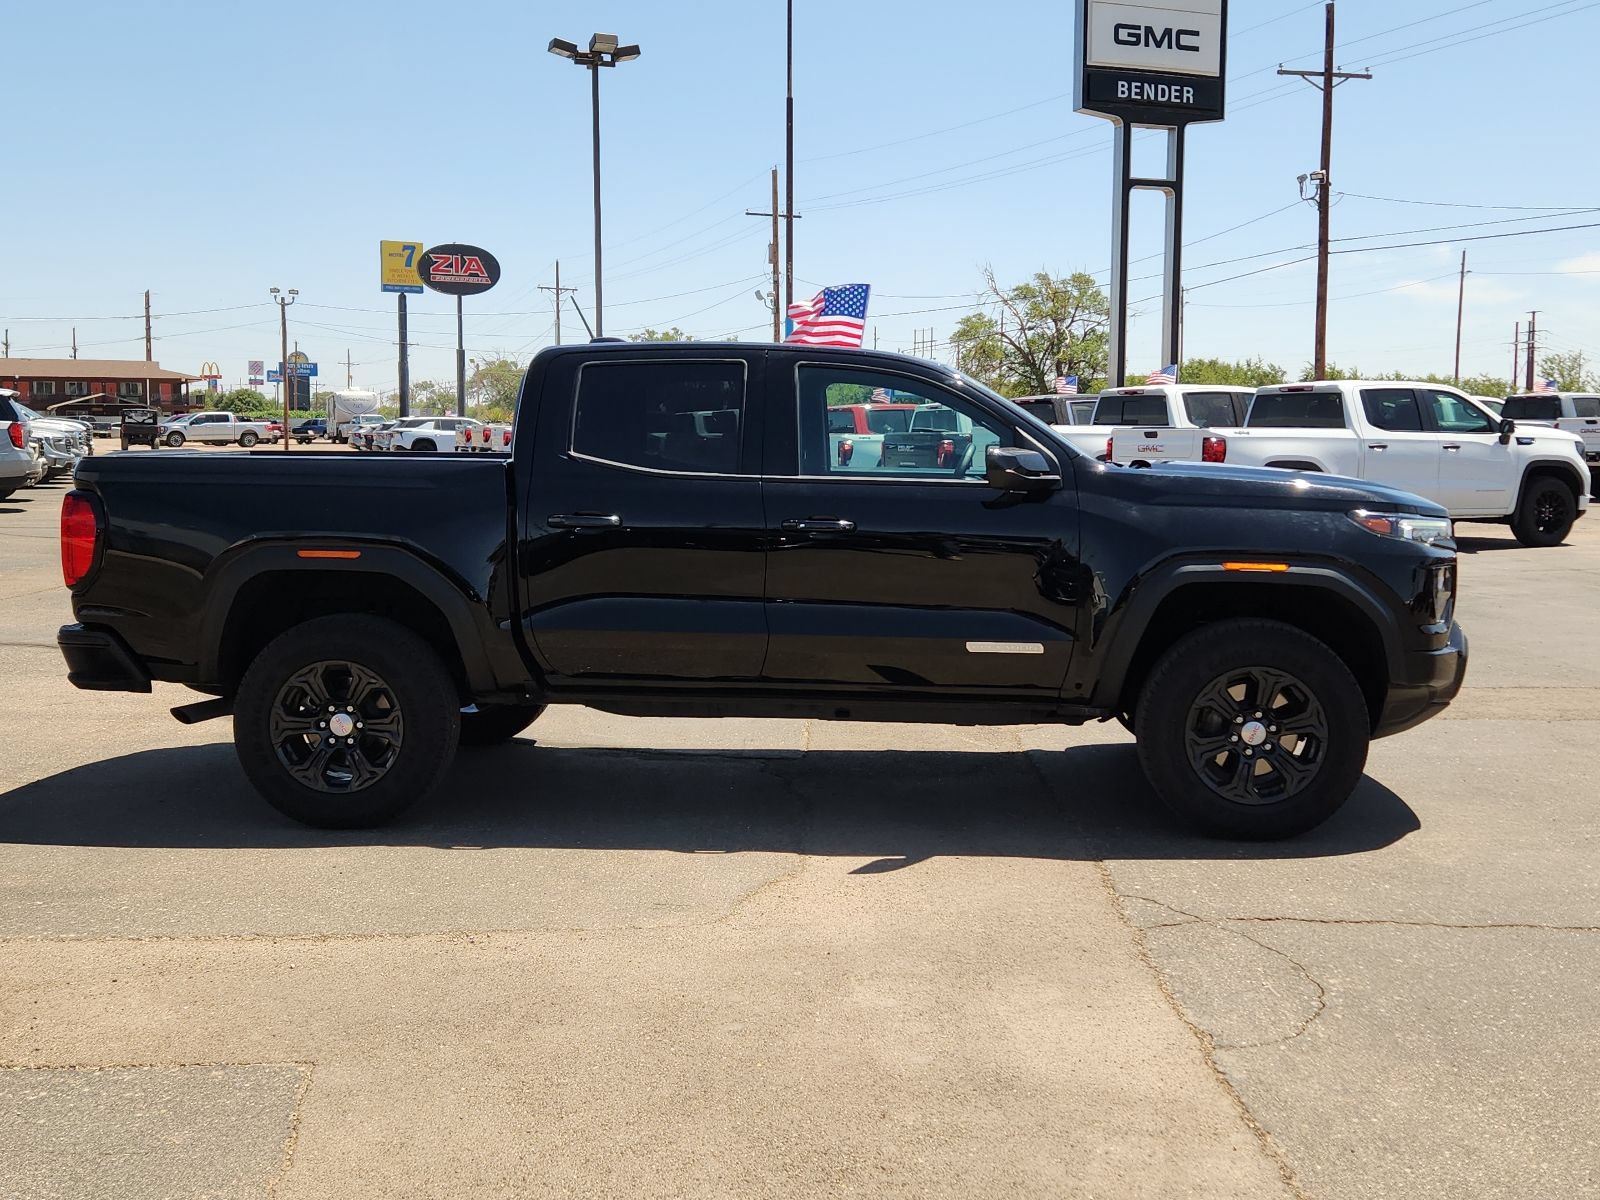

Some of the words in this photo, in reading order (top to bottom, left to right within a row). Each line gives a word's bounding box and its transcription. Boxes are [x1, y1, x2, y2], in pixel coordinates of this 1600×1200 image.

[1114, 23, 1200, 52] GMC
[1117, 80, 1193, 104] BENDER
[402, 245, 416, 268] 7
[428, 253, 488, 277] ZIA
